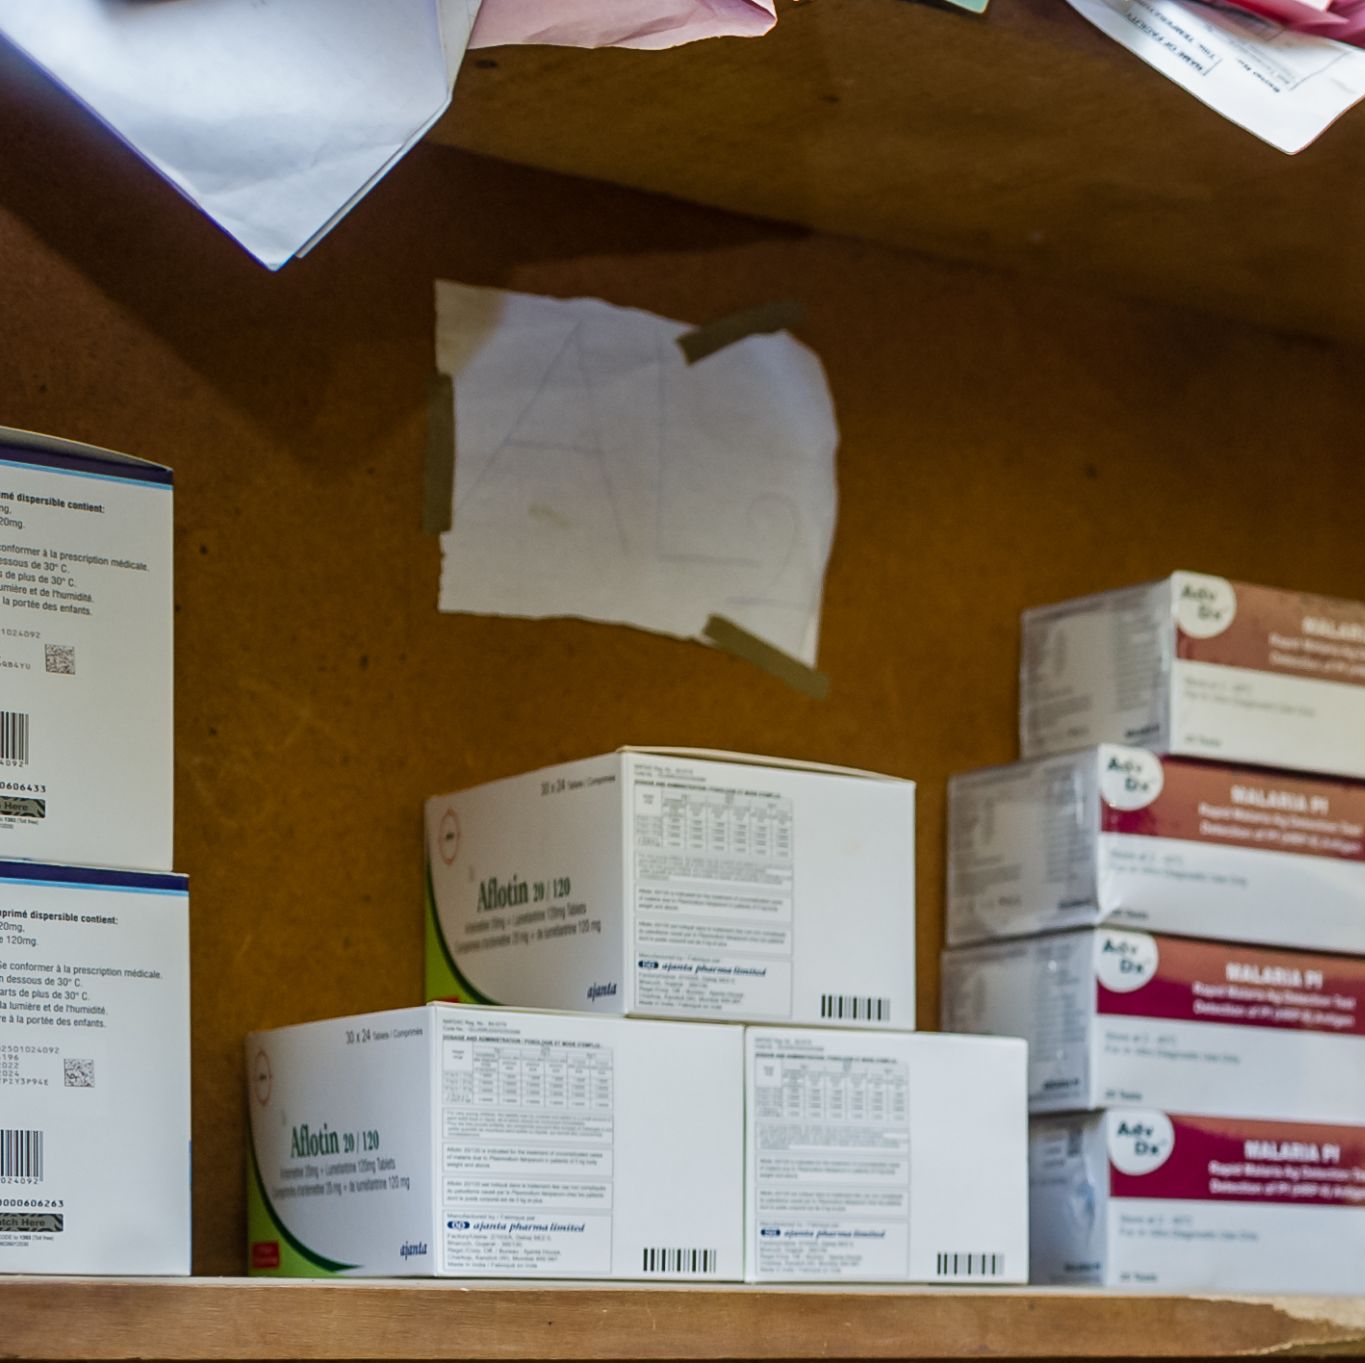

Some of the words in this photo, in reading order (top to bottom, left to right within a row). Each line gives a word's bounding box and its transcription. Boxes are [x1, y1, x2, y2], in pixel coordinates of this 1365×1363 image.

[17, 493, 66, 509] dispersible
[67, 501, 105, 514] contient:
[60, 552, 109, 567] prescription
[18, 572, 37, 584] plus
[12, 597, 40, 610] portée
[42, 602, 58, 612] des
[60, 604, 93, 617] enfants.
[477, 873, 530, 913] Aflotin
[30, 911, 79, 923] dispersible
[80, 915, 118, 926] contient:
[9, 963, 55, 974] conformer
[73, 966, 123, 979] prescription
[124, 968, 163, 980] médicale.
[7, 975, 43, 986] dessous
[45, 977, 55, 987] de
[19, 988, 30, 998] de
[31, 989, 50, 1000] plus
[52, 990, 62, 1000] de
[586, 981, 617, 1002] ajanta
[9, 1001, 41, 1012] lumière
[26, 1015, 54, 1026] portée
[56, 1016, 72, 1027] des
[73, 1017, 107, 1029] enfants.
[290, 1123, 340, 1159] Aflotin
[362, 1129, 379, 1152] 120
[473, 1220, 507, 1233] ajanta
[508, 1222, 549, 1234] pharma
[549, 1223, 586, 1234] limited
[400, 1240, 428, 1262] ajanta
